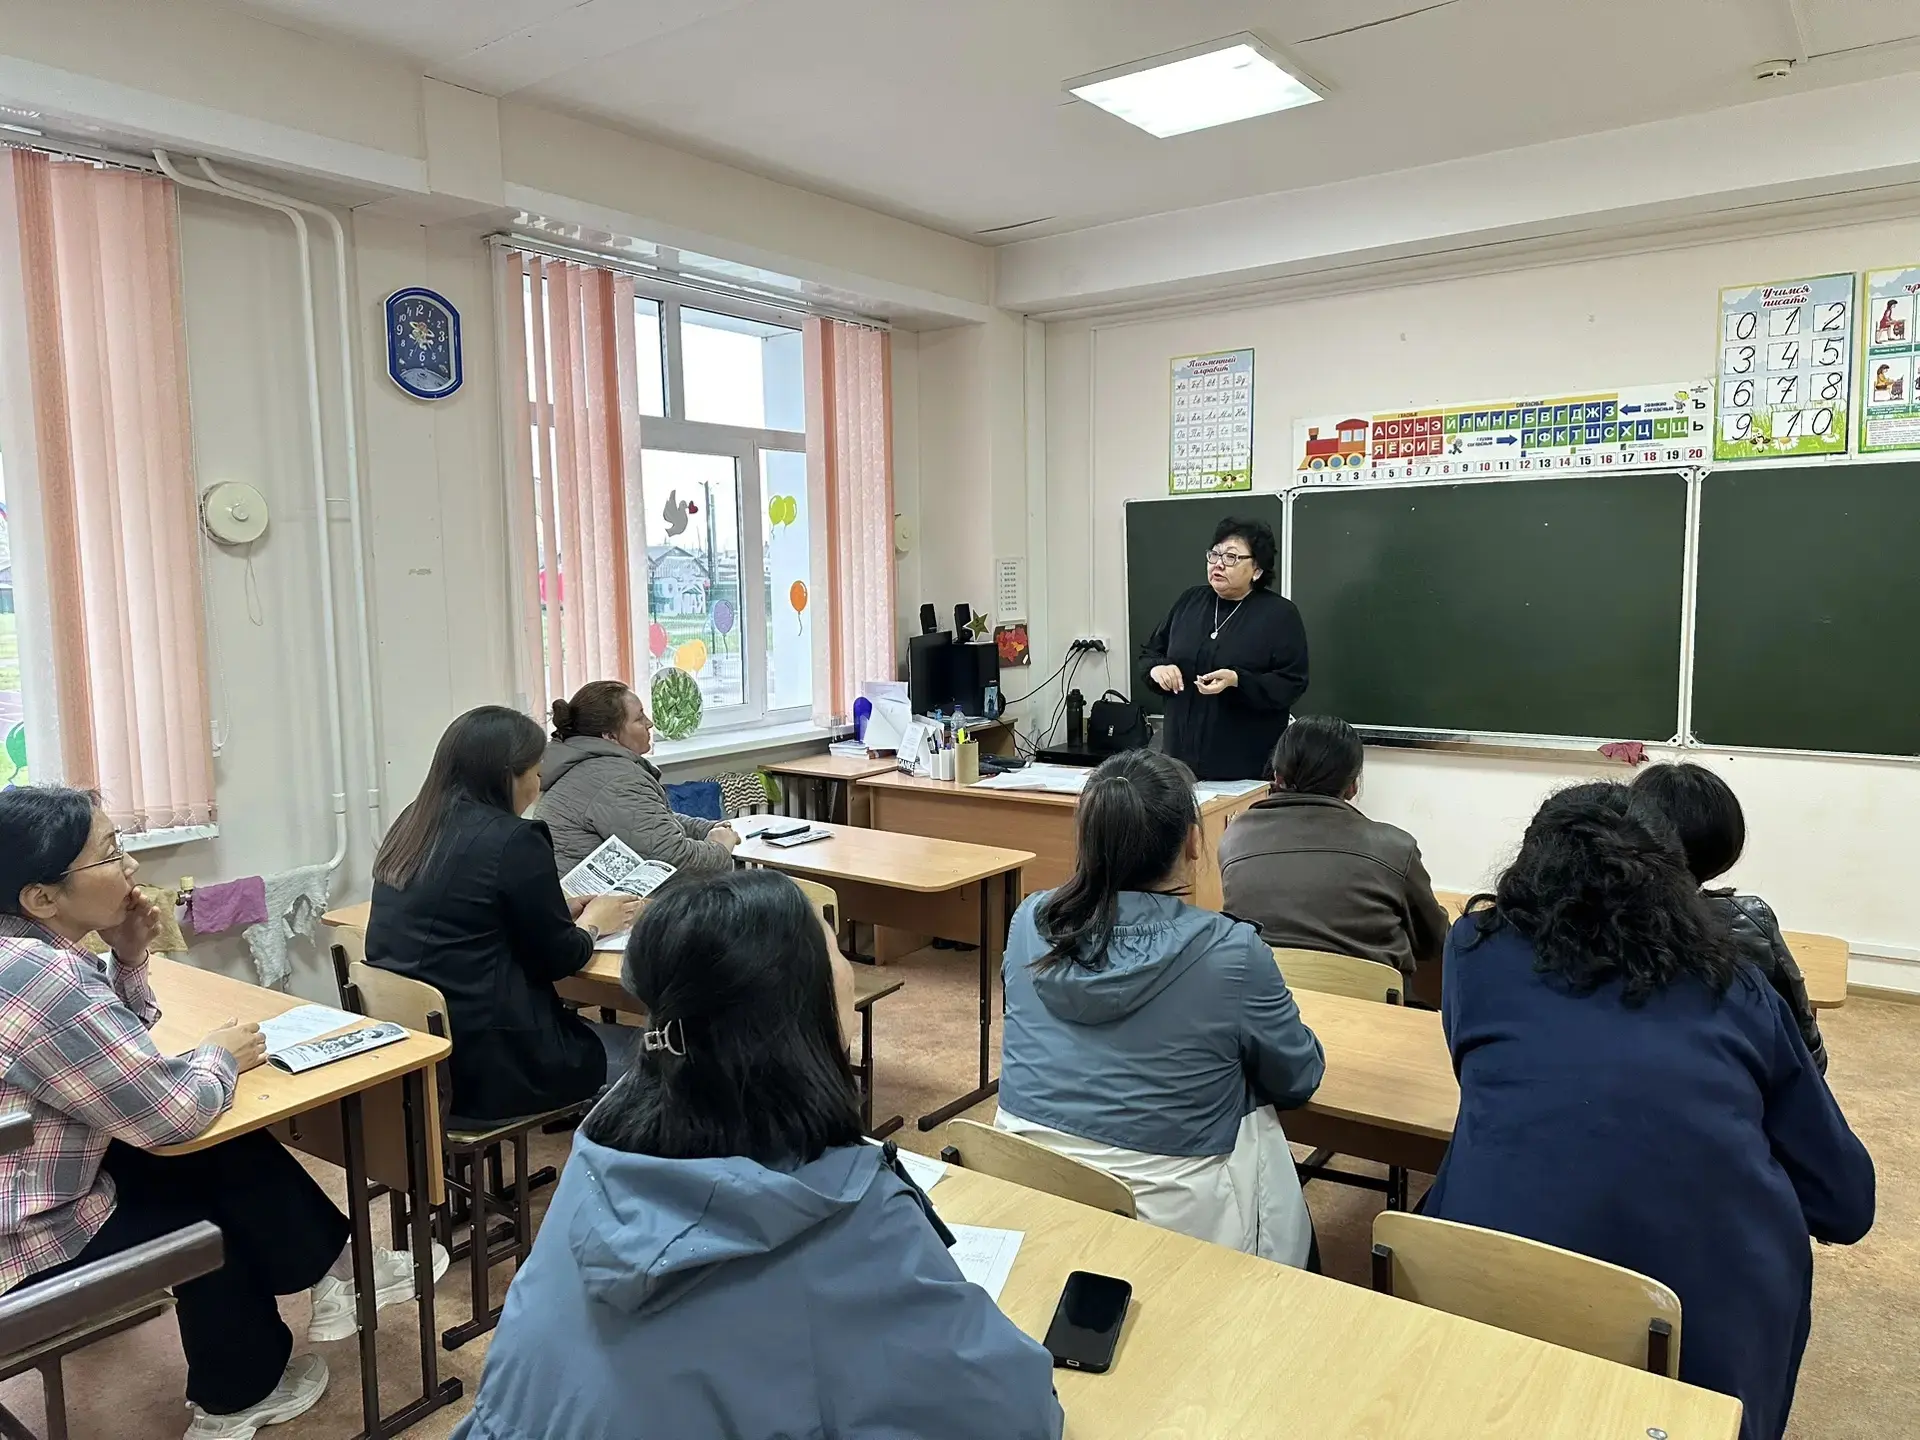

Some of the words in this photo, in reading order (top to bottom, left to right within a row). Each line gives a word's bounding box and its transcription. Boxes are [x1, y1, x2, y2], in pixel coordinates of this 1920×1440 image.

[1763, 285, 1809, 299] Учимся
[1763, 295, 1807, 307] писать
[407, 307, 412, 316] 11
[416, 305, 424, 316] 12
[399, 314, 406, 322] 10
[1736, 312, 1757, 339] 0
[1785, 307, 1801, 335] 1
[1822, 302, 1846, 331] 2
[396, 325, 403, 335] 9
[438, 331, 445, 342] 3
[409, 349, 414, 357] 7
[438, 345, 442, 353] 4
[420, 351, 426, 362] 6
[1733, 346, 1755, 373] 3
[1782, 342, 1798, 369] 4
[1819, 338, 1844, 365] 5
[1187, 356, 1236, 368] Письменный
[1193, 365, 1228, 375] алфавит
[1733, 380, 1754, 407] 6
[1777, 376, 1798, 403] 7
[1821, 372, 1842, 400] 8
[1374, 428, 1384, 437] А
[1388, 424, 1398, 435] О
[1403, 423, 1412, 434] У
[1416, 422, 1427, 432] Ы
[1432, 420, 1441, 431] Э
[1446, 416, 1456, 429] Й
[1461, 418, 1471, 428] Л
[1476, 417, 1487, 427] М
[1493, 416, 1501, 426] Н
[1509, 415, 1517, 425] Р
[1525, 413, 1534, 423] Б
[1541, 412, 1550, 422] В
[1557, 411, 1565, 420] Г
[1572, 409, 1582, 422] Д
[1586, 408, 1599, 418] Ж
[1605, 406, 1614, 417] З
[1692, 399, 1706, 409] Ъ
[1525, 433, 1533, 443] П
[1538, 431, 1551, 443] Ф
[1556, 431, 1565, 441] К
[1572, 430, 1581, 440] Т
[1586, 428, 1599, 439] Ш
[1604, 427, 1614, 437] С
[1622, 426, 1633, 436] Х
[1639, 424, 1650, 436] Ц
[1657, 423, 1667, 433] Ч
[1672, 421, 1688, 433] Щ
[1693, 421, 1703, 431] Ь
[1732, 413, 1752, 440] 9
[1374, 445, 1384, 455] Я
[1388, 440, 1398, 454] Ё
[1401, 442, 1414, 453] Ю
[1417, 441, 1426, 452] И
[1431, 440, 1440, 450] Е
[1302, 475, 1308, 483] 0
[1319, 474, 1323, 482] 1
[1336, 473, 1341, 481] 2
[1353, 472, 1359, 480] 3
[1371, 470, 1377, 478] 4
[1388, 469, 1394, 478] 5
[1406, 468, 1412, 476] 6
[1425, 467, 1430, 475] 7
[1443, 465, 1449, 473] 8
[1462, 463, 1468, 472] 9
[1480, 462, 1491, 471] 10
[1499, 461, 1509, 470] 11
[1520, 460, 1531, 469] 12
[1540, 459, 1551, 468] 13
[1559, 458, 1570, 466] 14
[1580, 456, 1591, 465] 15
[1600, 455, 1612, 464] 16
[1622, 453, 1634, 463] 17
[1644, 452, 1657, 461] 18
[1667, 450, 1679, 460] 19
[1688, 449, 1703, 458] 20
